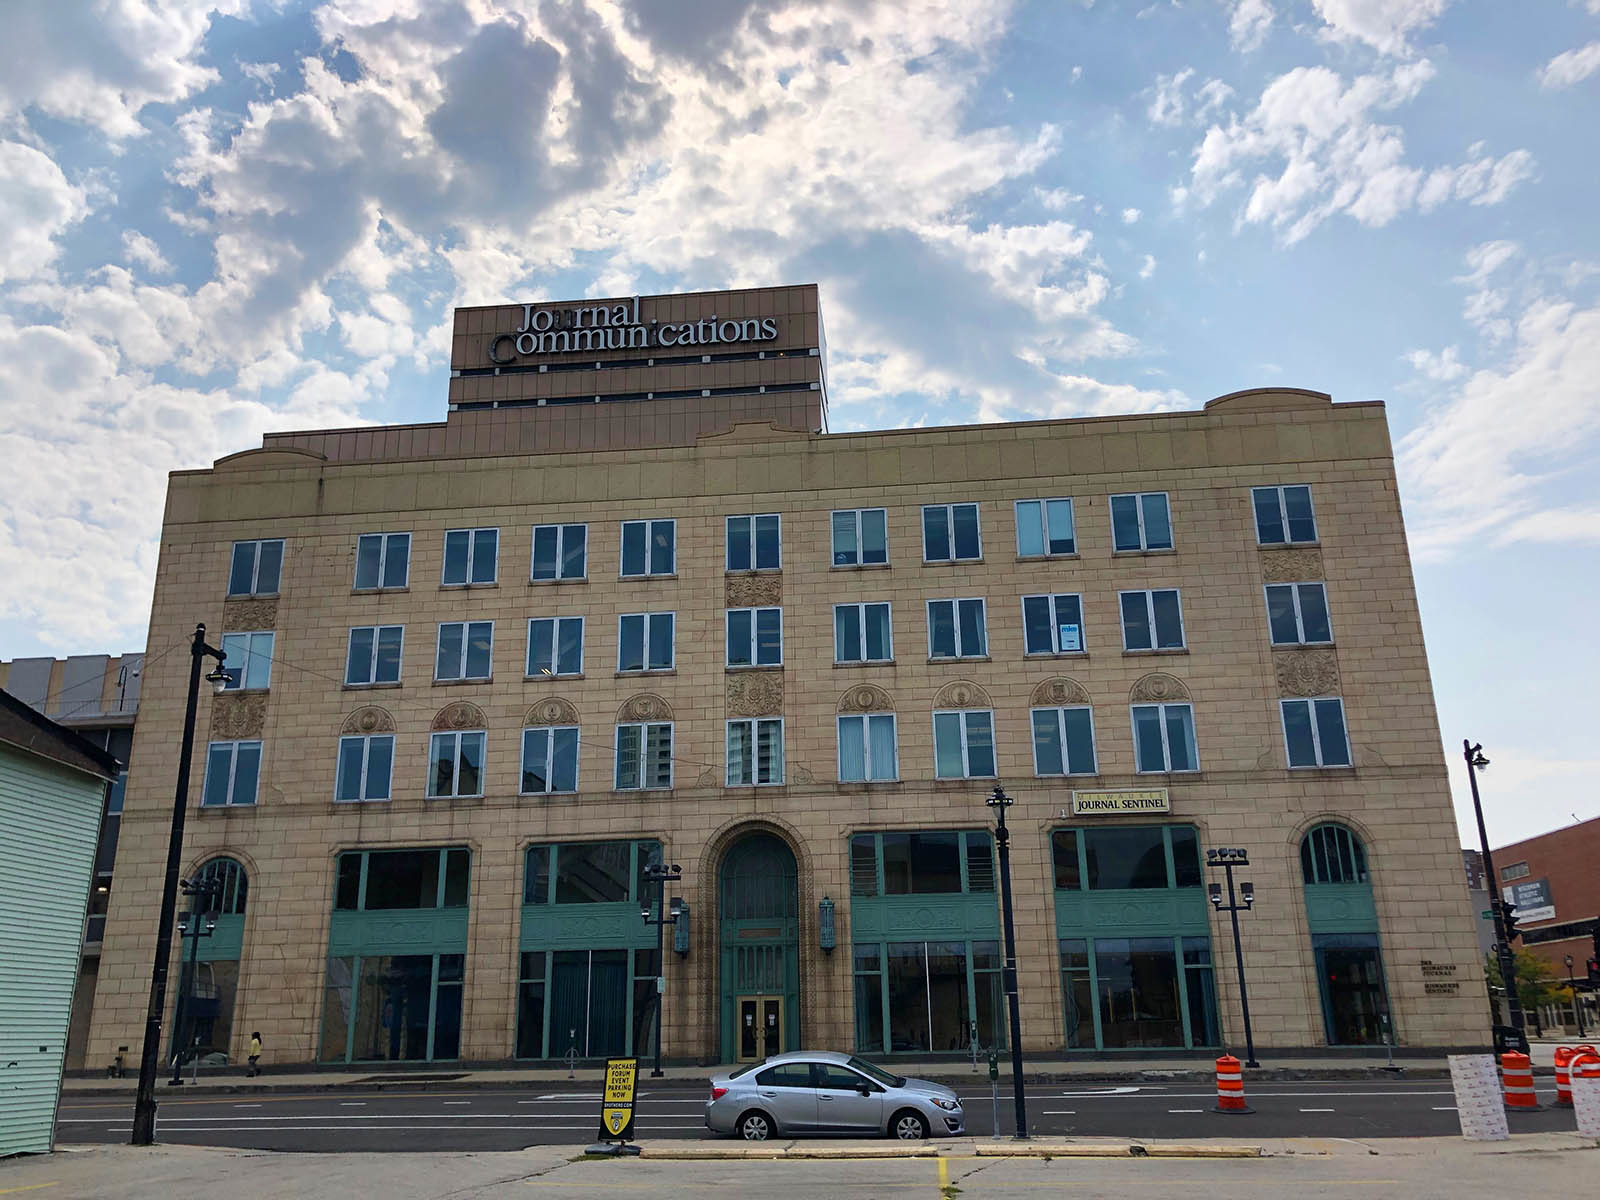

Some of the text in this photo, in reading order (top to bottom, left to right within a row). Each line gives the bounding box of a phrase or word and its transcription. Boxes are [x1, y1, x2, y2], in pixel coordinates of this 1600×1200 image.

[517, 296, 642, 332] Journal
[488, 315, 777, 364] Communications
[1077, 799, 1166, 812] JOURNAL SENTINEL
